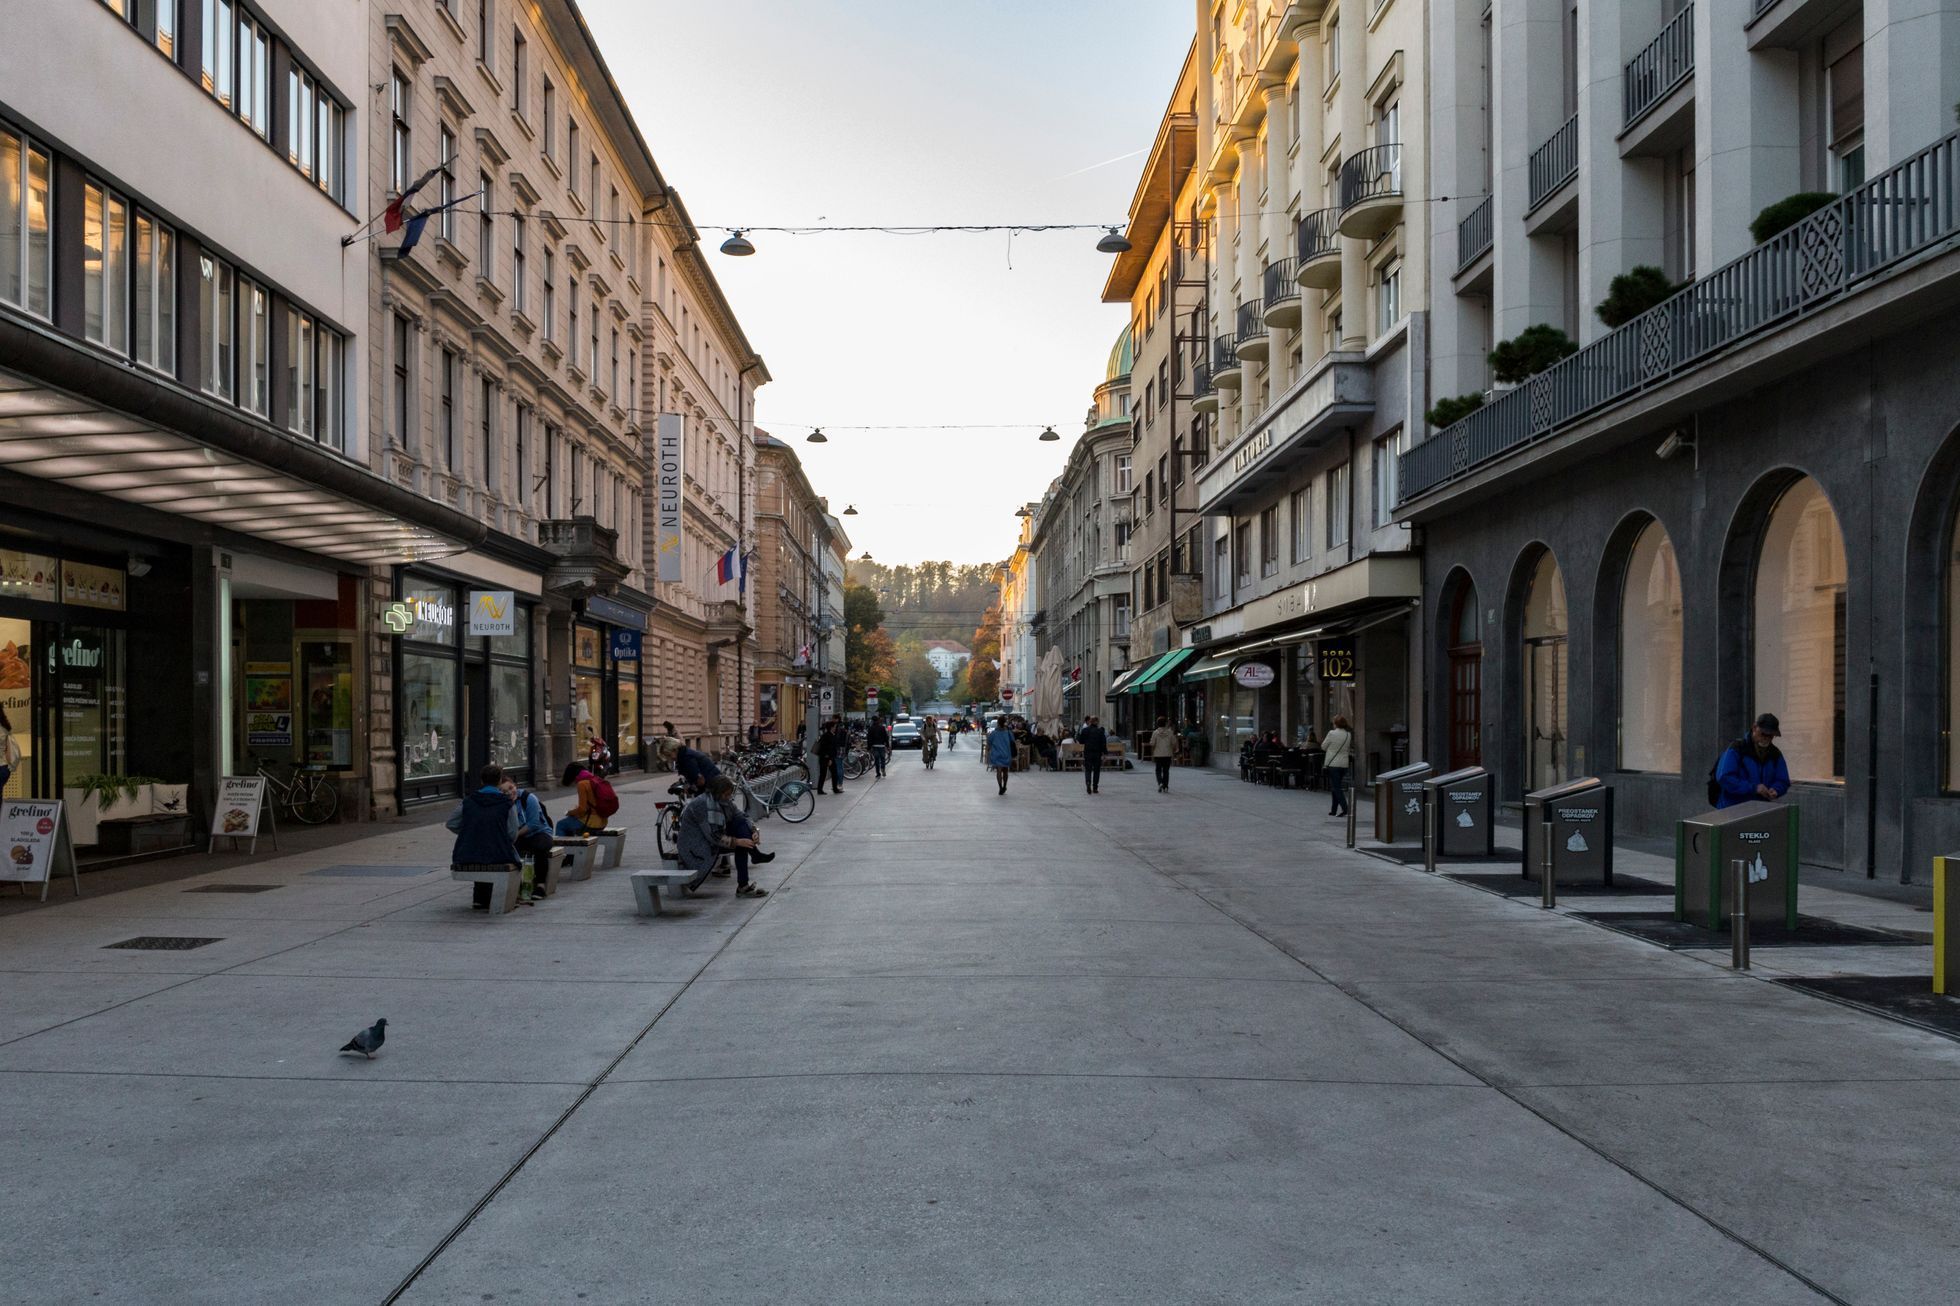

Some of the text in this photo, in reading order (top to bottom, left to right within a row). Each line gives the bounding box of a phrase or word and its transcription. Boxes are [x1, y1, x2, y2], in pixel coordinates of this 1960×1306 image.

[1232, 429, 1272, 473] VIKTORIA
[662, 438, 677, 527] NEUROTH
[417, 601, 453, 626] NEUROTH
[49, 639, 100, 674] gefino
[614, 647, 637, 659] Optika
[1320, 658, 1353, 677] 102
[1, 696, 30, 709] efino
[226, 780, 258, 790] grefino
[9, 805, 52, 819] grefino
